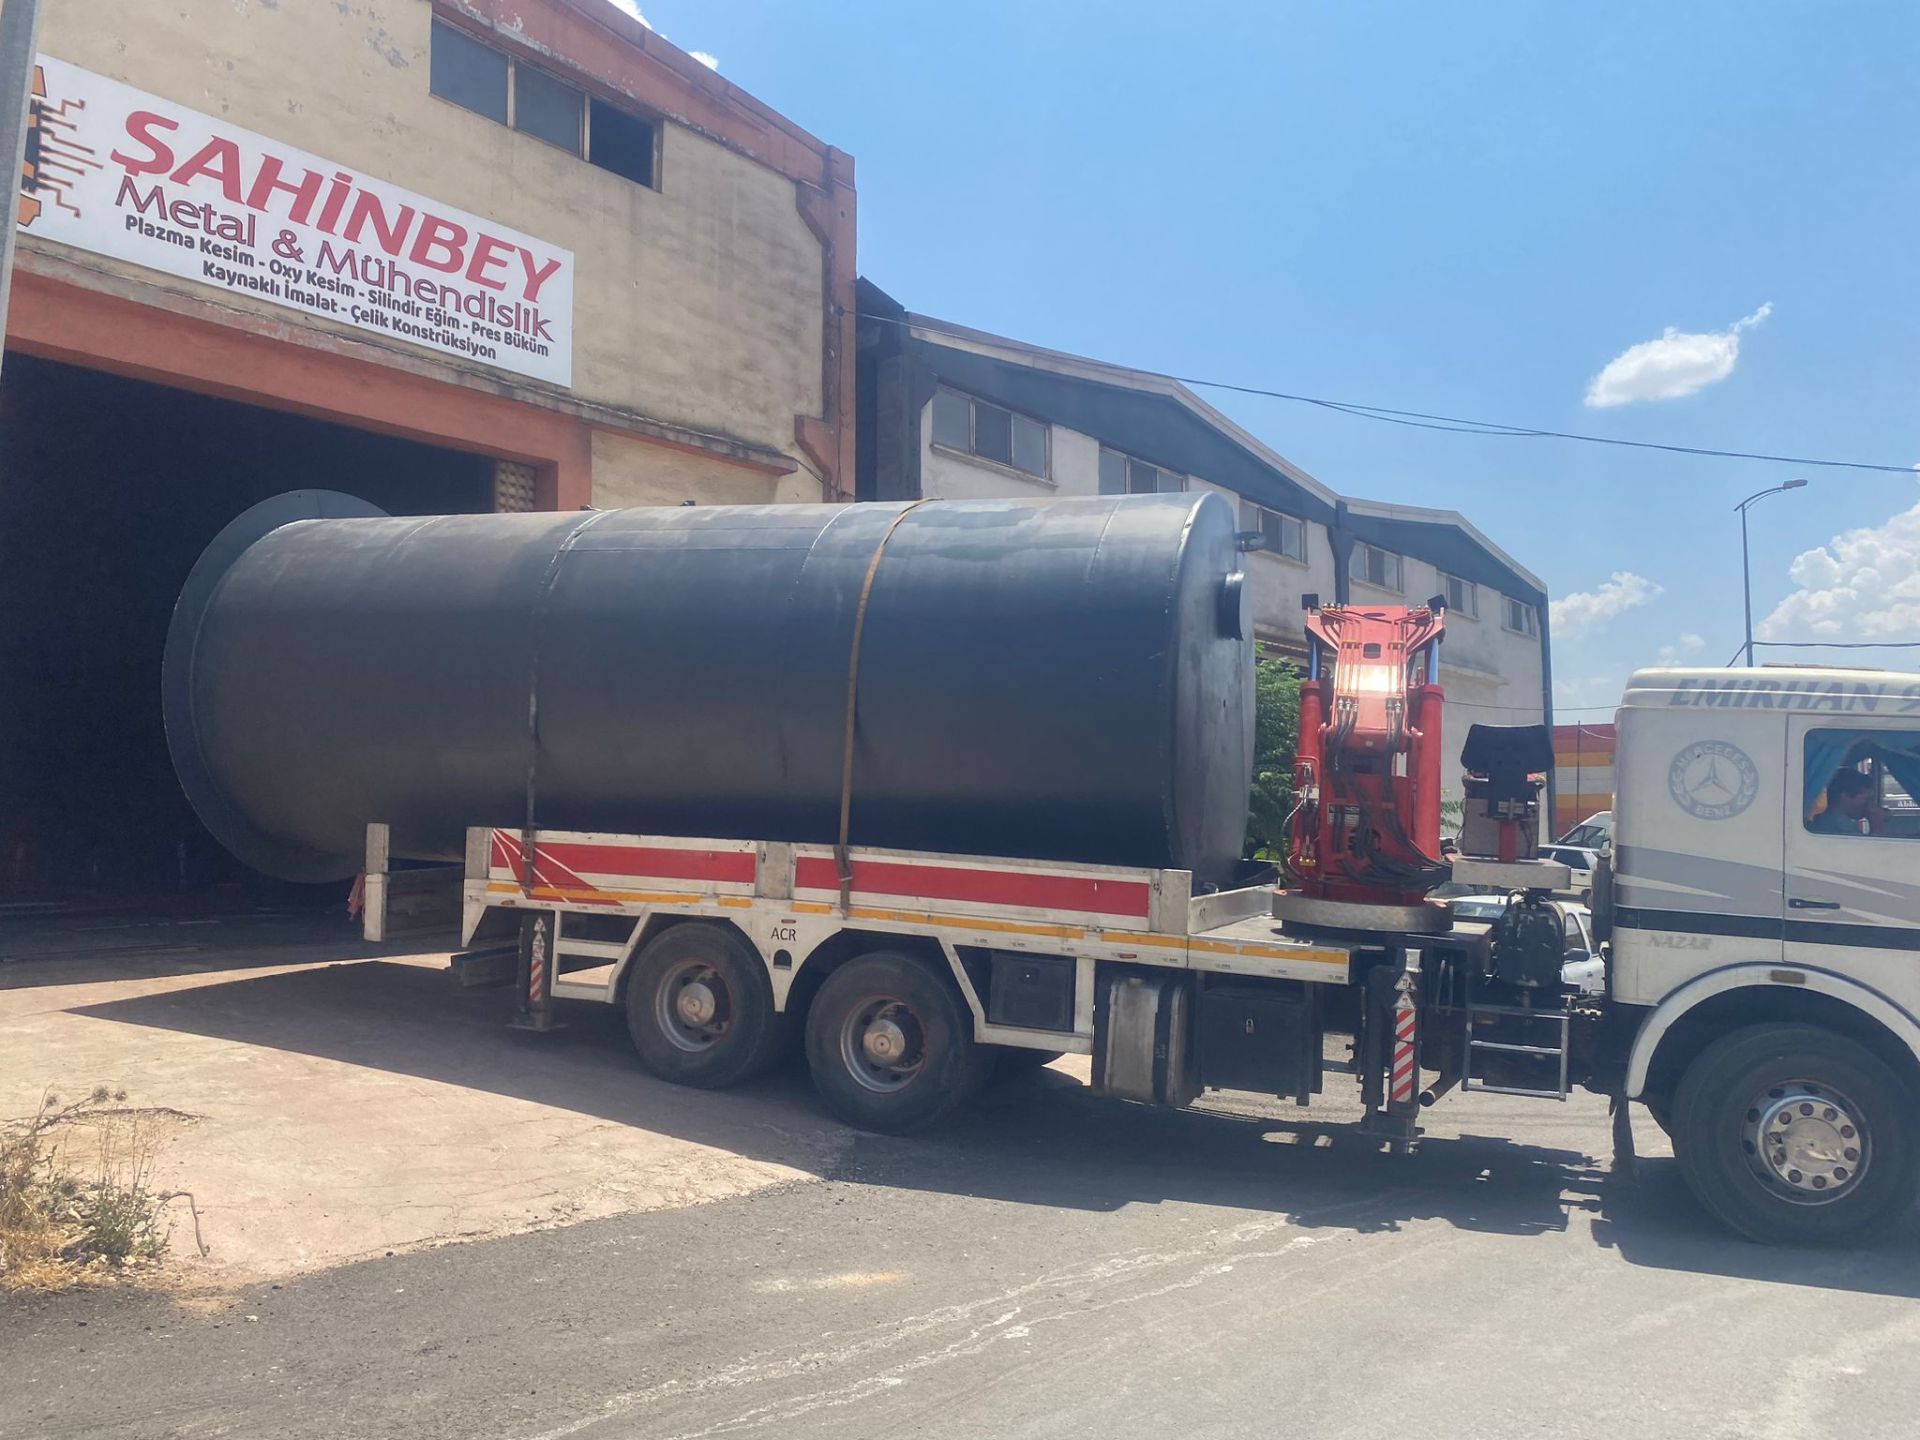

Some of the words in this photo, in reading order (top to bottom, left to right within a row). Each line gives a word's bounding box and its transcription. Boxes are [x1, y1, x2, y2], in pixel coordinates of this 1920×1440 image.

[110, 111, 561, 303] ŞAHİNBEY
[115, 174, 256, 248] Metal
[271, 229, 304, 263] &
[316, 240, 555, 342] Mühendislik
[125, 215, 195, 249] Plazma
[200, 237, 254, 267] Kesim
[269, 259, 303, 284] Oxy
[306, 271, 355, 298] Kesim
[368, 289, 422, 318] Silindir
[425, 305, 460, 330] Eğim
[471, 321, 501, 342] Pres
[504, 332, 549, 357] Büküm
[203, 260, 280, 297] Kaynaklı
[284, 281, 338, 313] İmalat
[350, 304, 389, 324] Çelik
[392, 316, 496, 360] Konstrüksiyon
[771, 927, 797, 942] ACR
